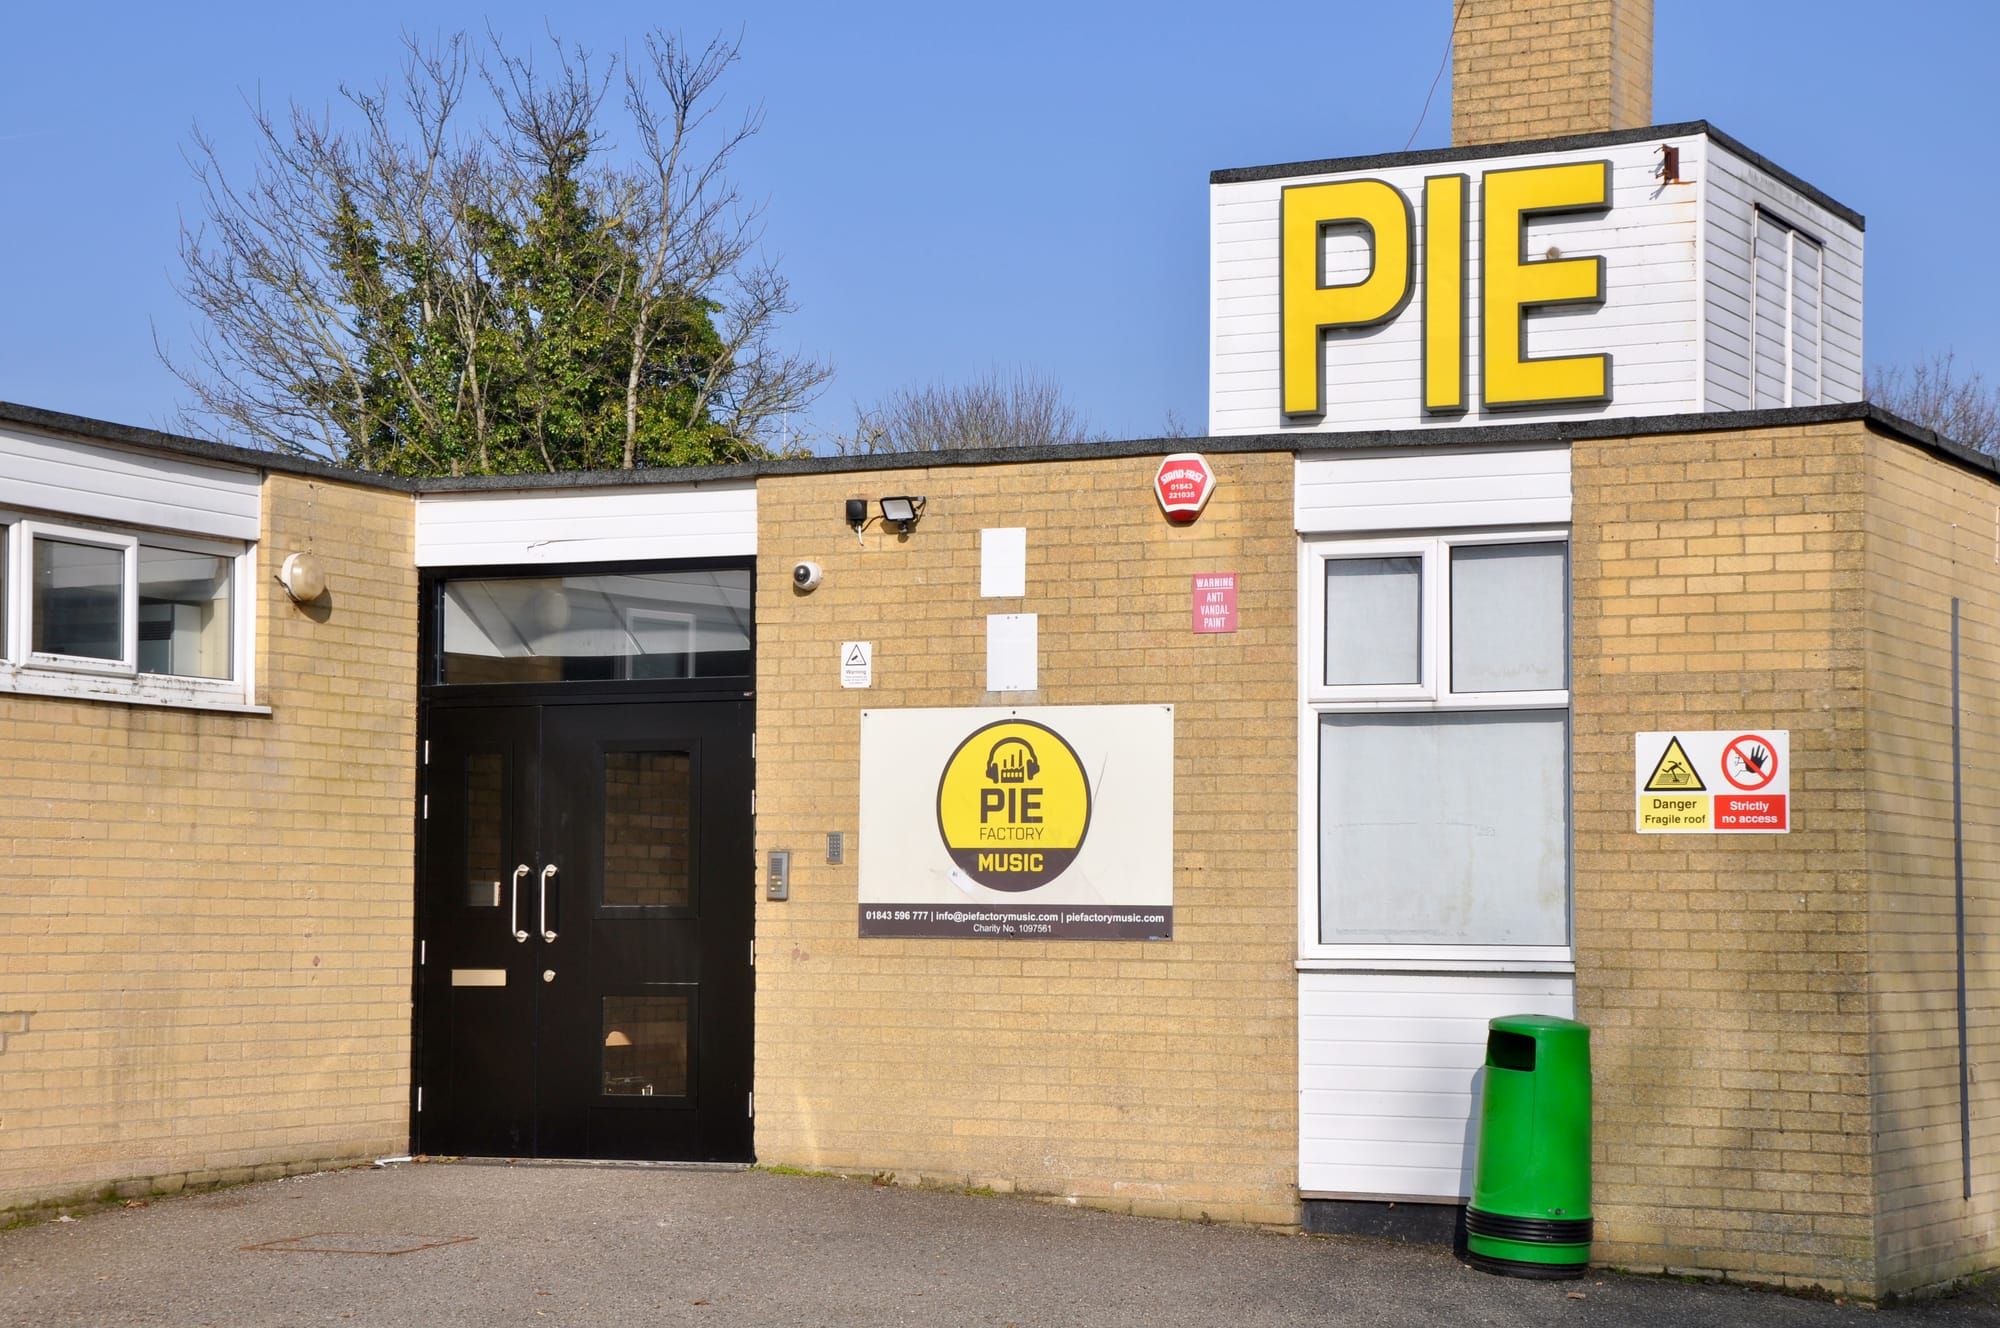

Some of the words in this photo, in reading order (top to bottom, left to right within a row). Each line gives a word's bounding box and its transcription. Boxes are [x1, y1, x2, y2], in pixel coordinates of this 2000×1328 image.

[1281, 159, 1613, 417] PIE
[1168, 491, 1195, 499] 221035
[1195, 577, 1234, 588] WARNING
[1206, 592, 1224, 603] ANTI
[1200, 604, 1230, 616] VANDAL
[1203, 617, 1226, 629] PAINT
[980, 788, 1043, 823] PIE
[1653, 799, 1697, 811] Danger
[1729, 801, 1769, 813] Strictly
[1644, 814, 1681, 826] Fragile
[1684, 814, 1706, 824] roof
[1721, 816, 1737, 824] no
[1739, 816, 1778, 824] access
[979, 827, 1044, 840] FACTORY
[978, 853, 1044, 872] MUSIC
[865, 910, 892, 920] 01843
[894, 910, 910, 920] 596
[913, 911, 928, 921] 777
[936, 911, 1058, 923] info@piefactorymusic.com
[1066, 912, 1164, 924] piefactorymusic.com
[973, 923, 1001, 934] Charity
[1002, 924, 1016, 933] No.
[1018, 925, 1052, 933] 1097561
